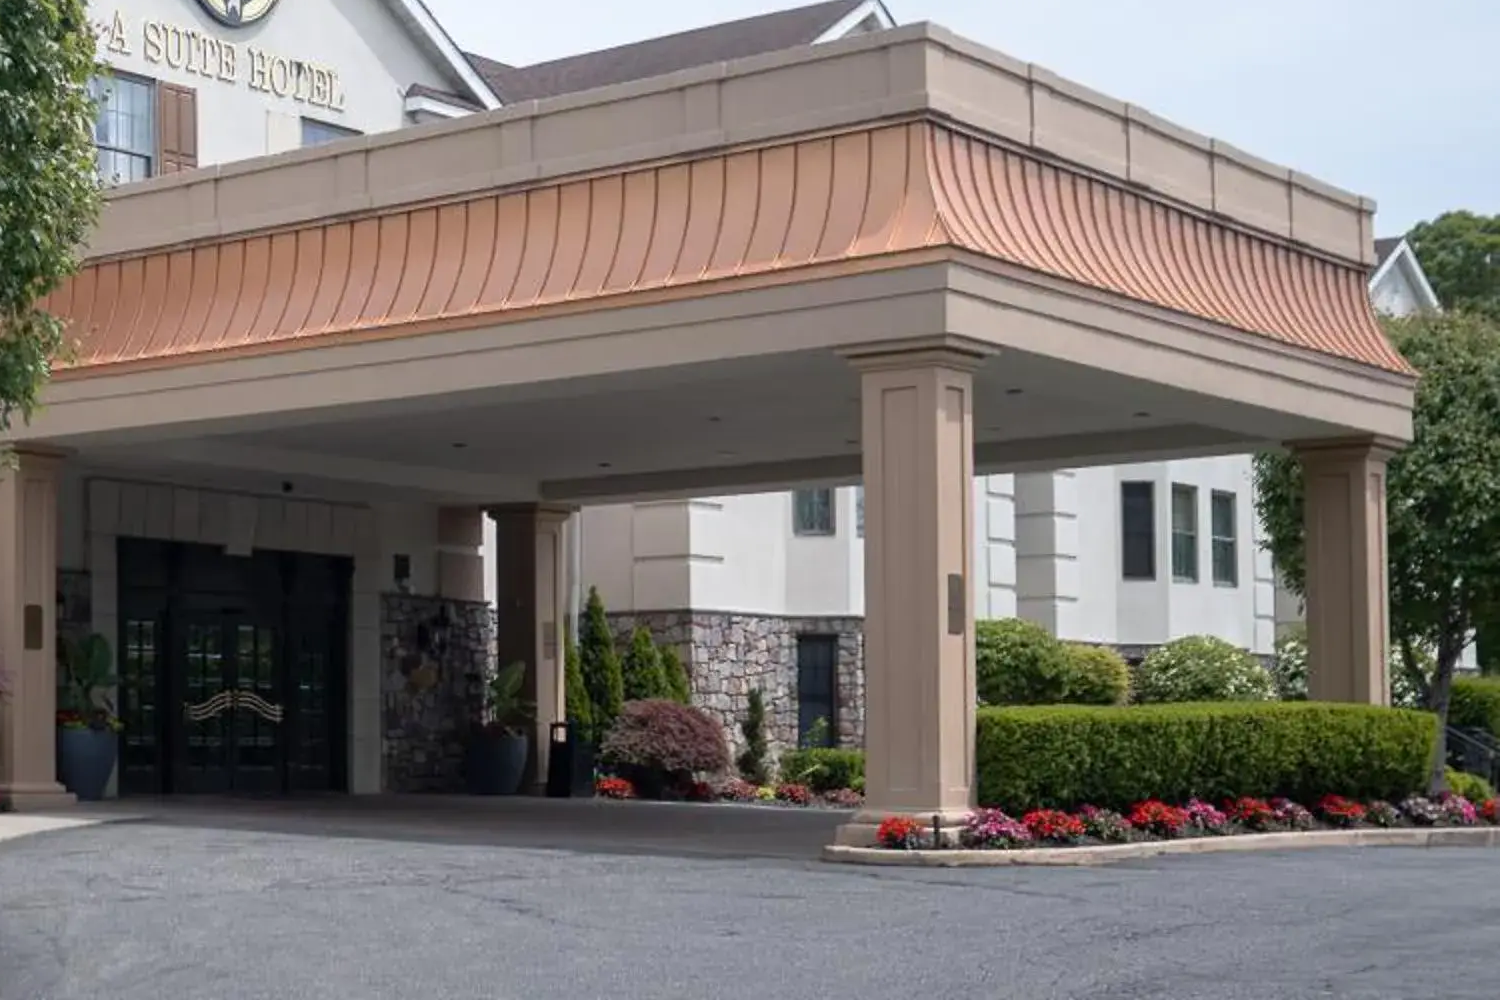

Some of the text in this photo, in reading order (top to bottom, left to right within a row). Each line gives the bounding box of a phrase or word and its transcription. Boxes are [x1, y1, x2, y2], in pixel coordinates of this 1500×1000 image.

[107, 9, 344, 112] A SUITE HOTEL
